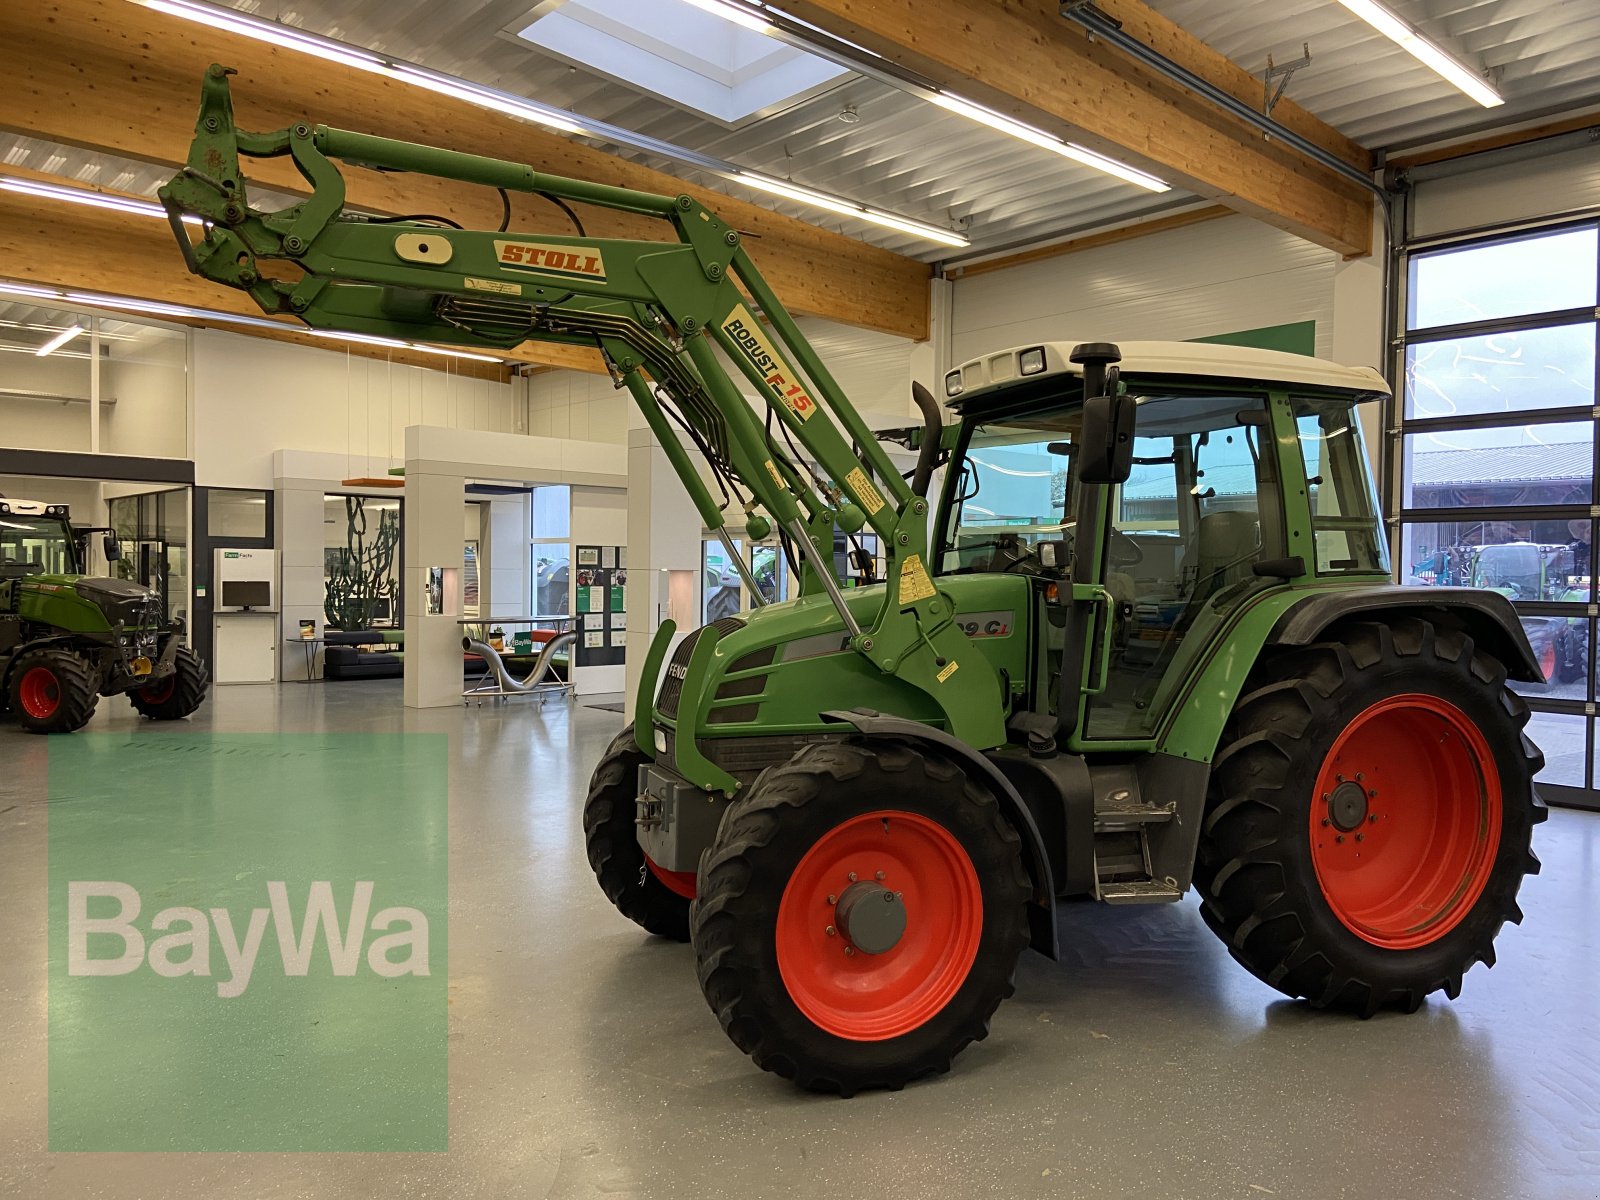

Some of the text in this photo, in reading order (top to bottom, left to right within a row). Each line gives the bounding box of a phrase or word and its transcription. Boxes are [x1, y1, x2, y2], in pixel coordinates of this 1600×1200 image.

[501, 244, 601, 274] STOLL
[727, 318, 779, 373] ROBUST
[668, 663, 688, 680] FEND
